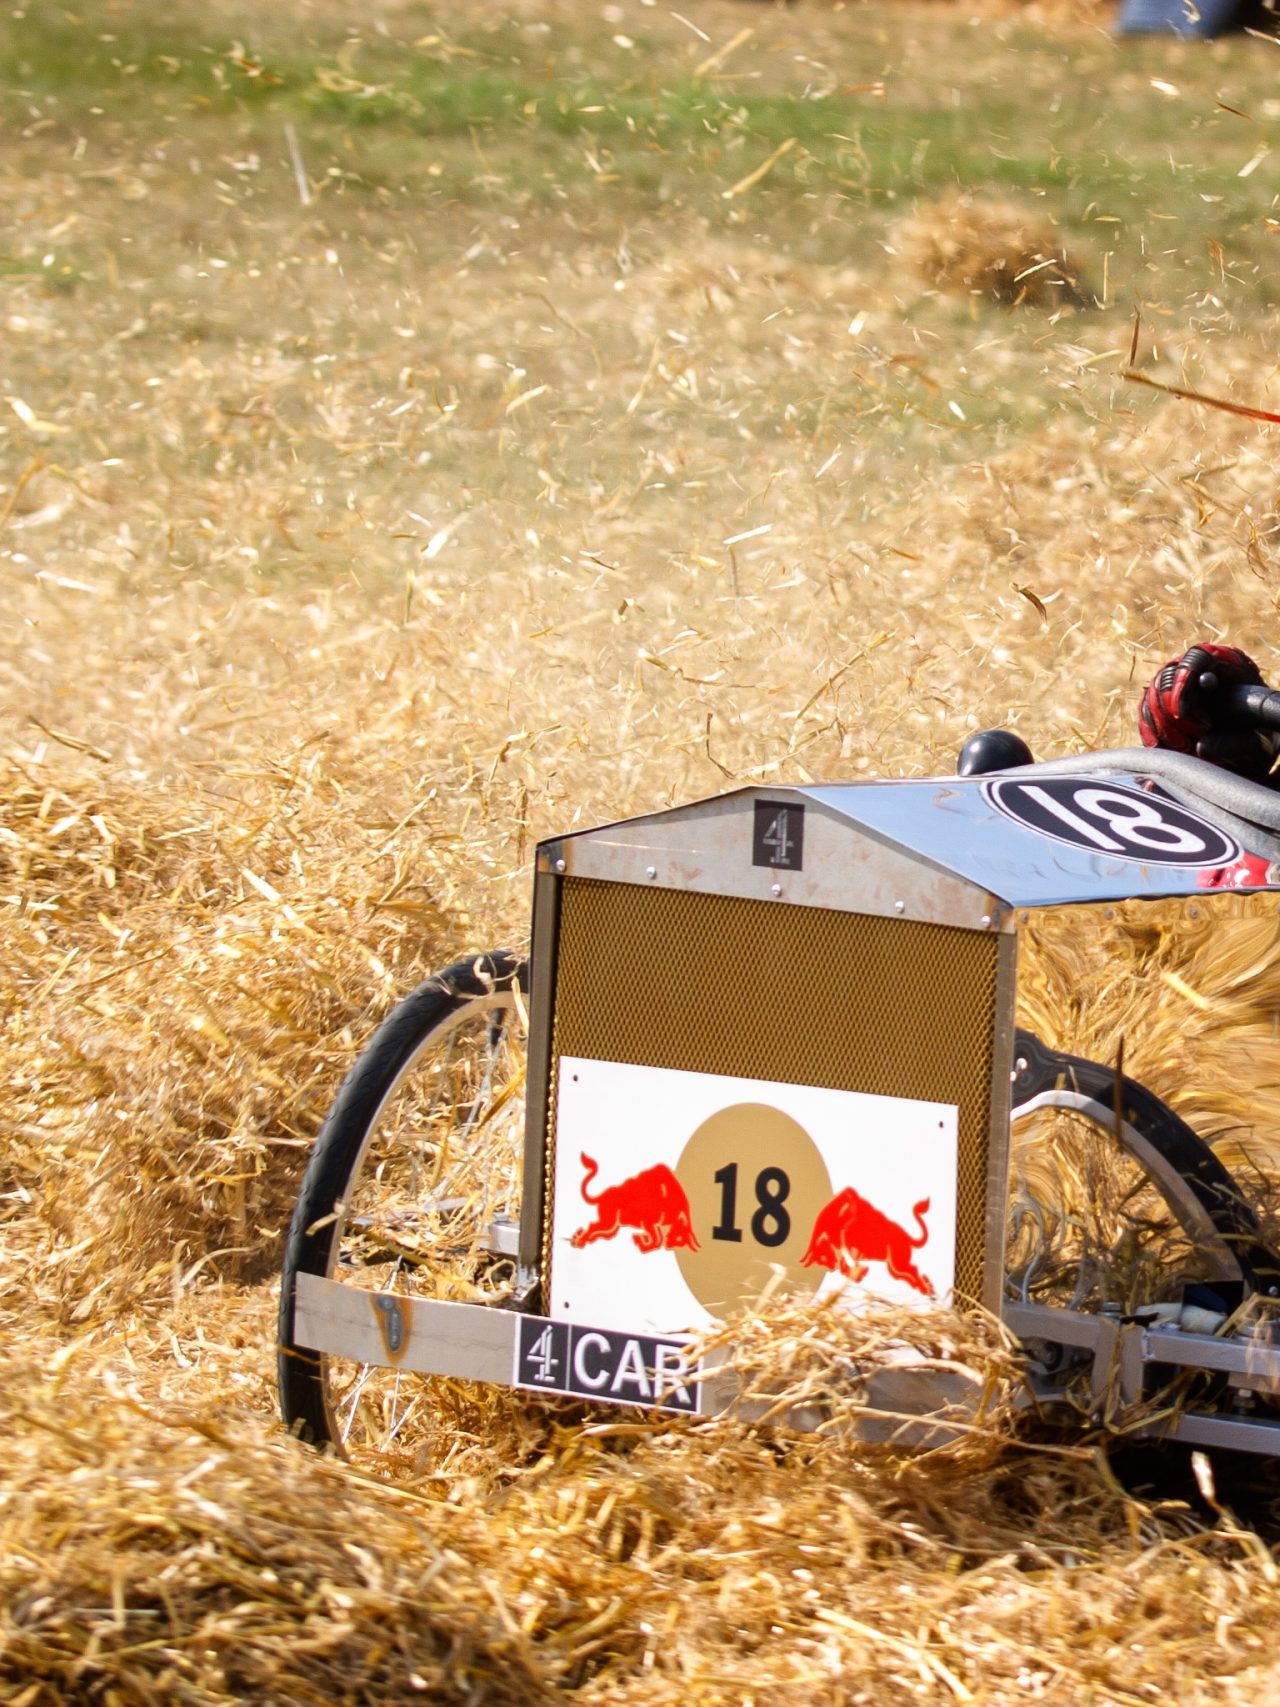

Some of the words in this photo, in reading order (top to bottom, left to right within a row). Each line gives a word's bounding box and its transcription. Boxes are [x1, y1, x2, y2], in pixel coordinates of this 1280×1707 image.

[762, 809, 795, 865] 4
[1017, 785, 1206, 853] 18
[712, 1162, 792, 1248] 18
[526, 1324, 559, 1383] 4
[574, 1332, 692, 1404] CAR
